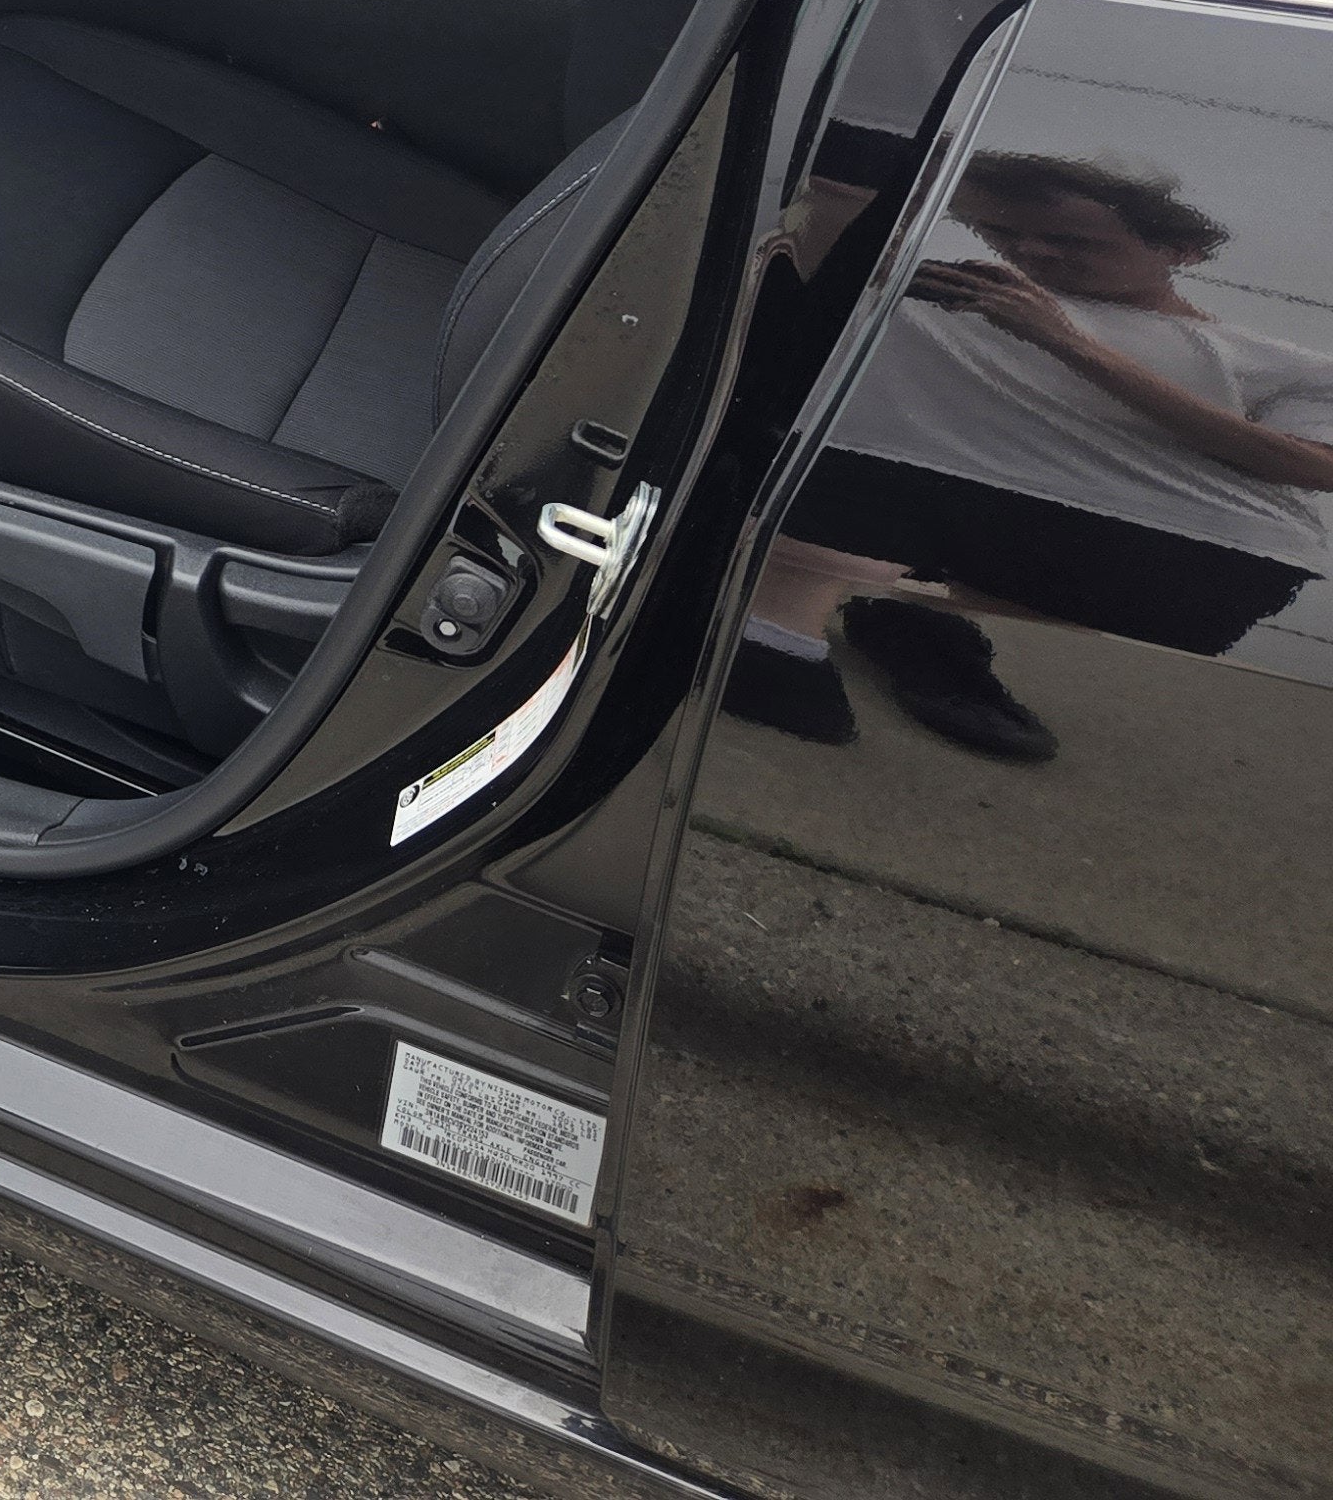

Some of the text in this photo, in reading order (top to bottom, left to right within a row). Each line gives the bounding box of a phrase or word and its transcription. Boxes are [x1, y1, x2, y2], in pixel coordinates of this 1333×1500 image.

[404, 1051, 471, 1082] MANUFACTURED
[487, 1082, 522, 1101] NISSAN
[523, 1096, 553, 1113] MOTOR
[431, 1080, 453, 1094] VEHICLE
[453, 1088, 483, 1105] CONFORMS
[502, 1106, 534, 1125] APPLICABLE
[534, 1118, 558, 1134] FEDERAL
[418, 1082, 439, 1097] VEHICLE
[461, 1099, 484, 1114] BUMPER
[514, 1118, 547, 1137] PREVENTION
[423, 1092, 442, 1106] EFFECT
[485, 1115, 523, 1136] MANUFACTURE
[524, 1130, 544, 1144] SHOWN
[450, 1110, 472, 1124] MANUAL
[485, 1123, 515, 1141] ADDITIONAL
[395, 1103, 423, 1120] COLOR
[522, 1152, 557, 1172] ENGINE
[522, 1146, 554, 1164] PASSENGER
